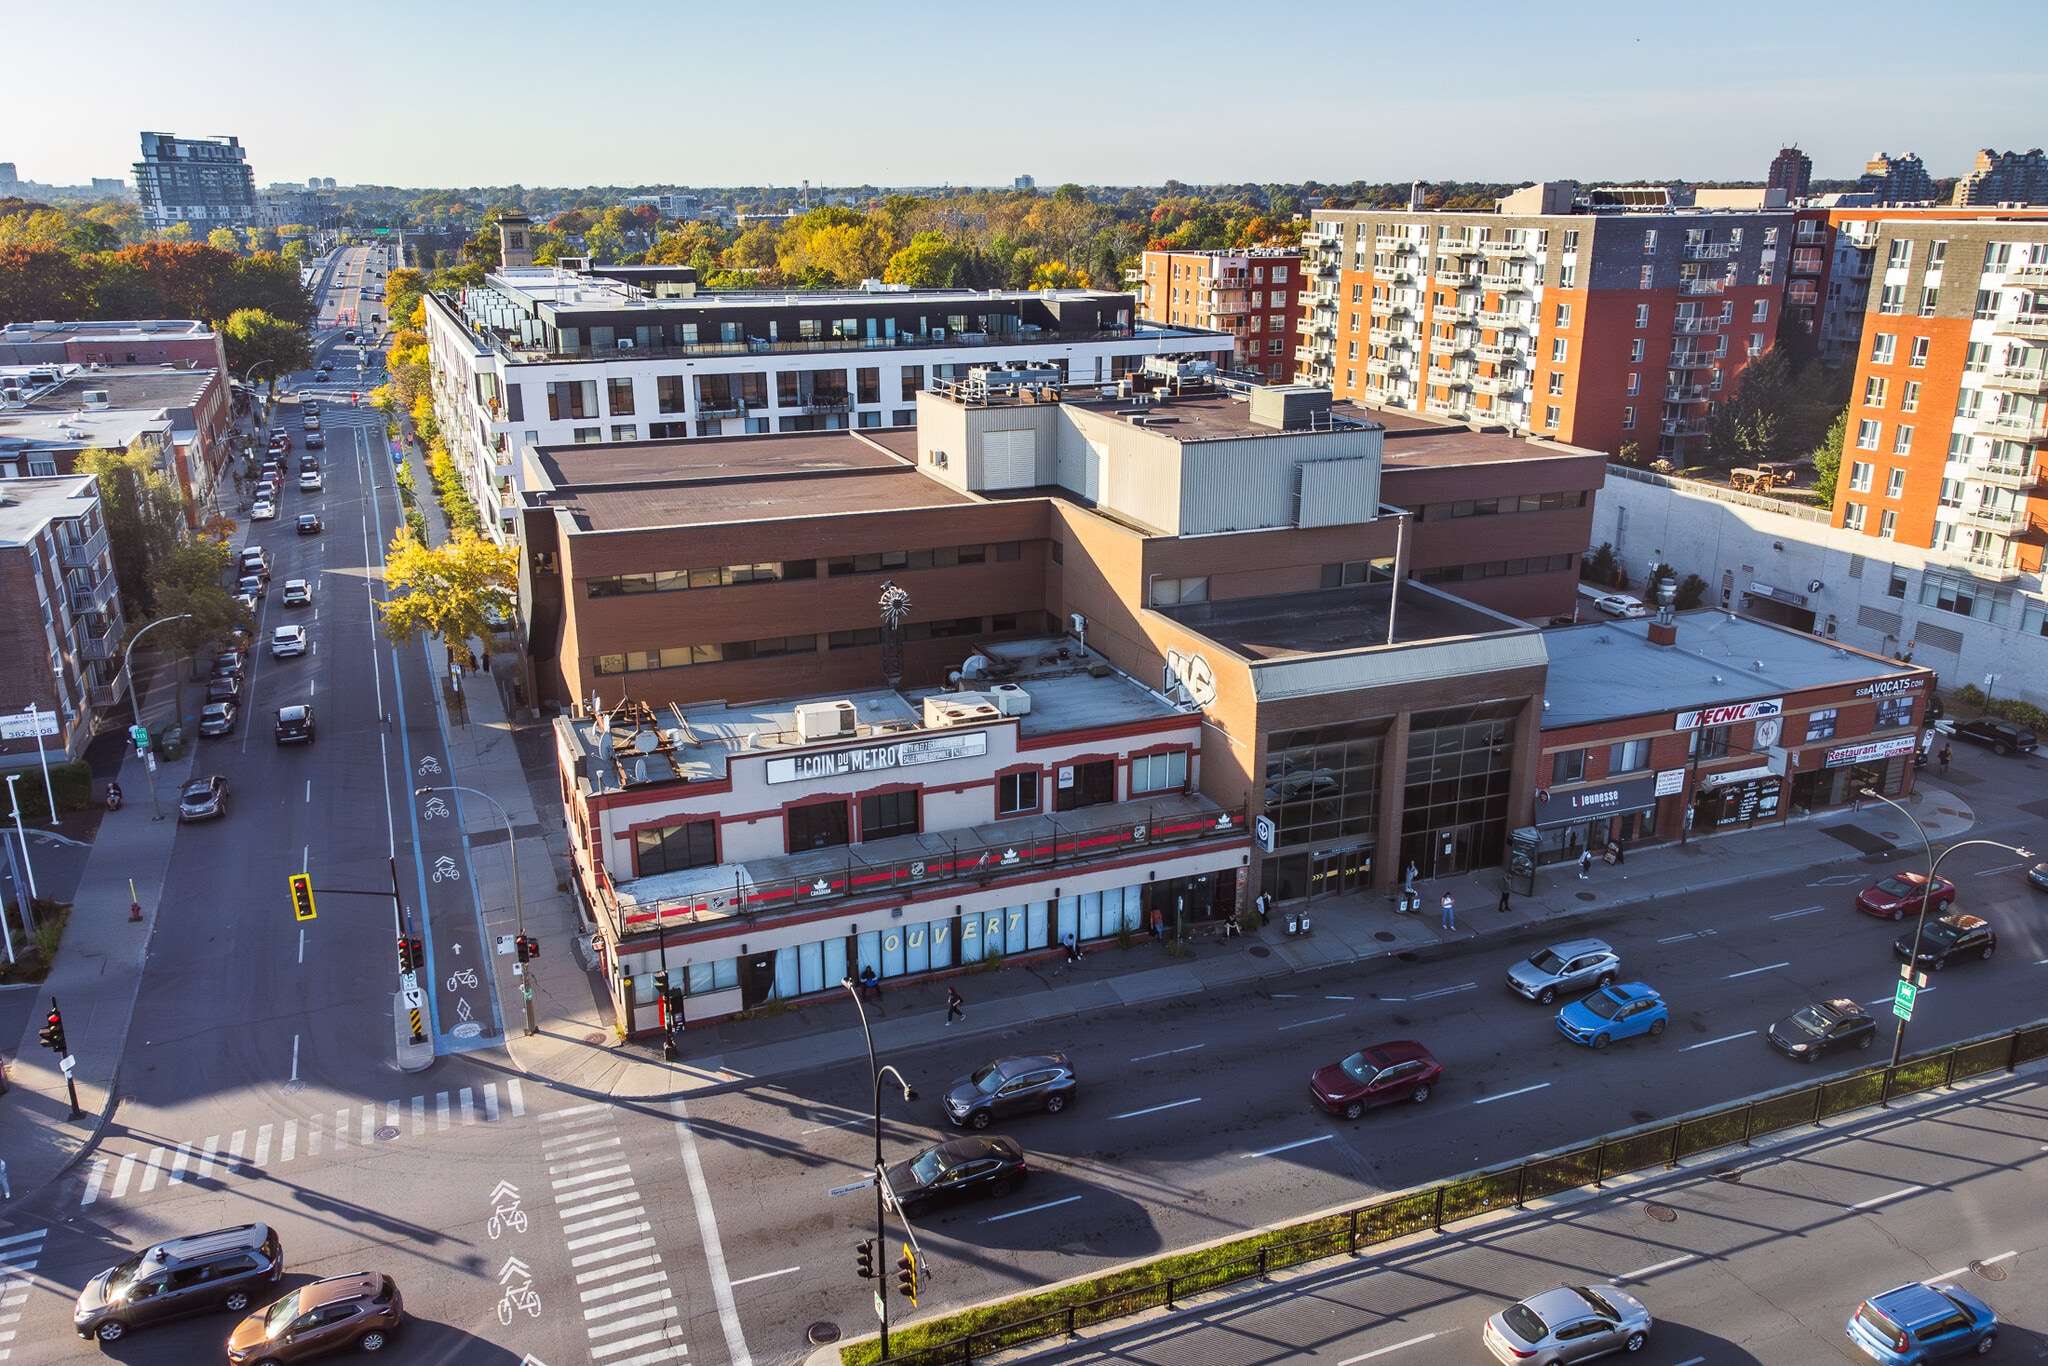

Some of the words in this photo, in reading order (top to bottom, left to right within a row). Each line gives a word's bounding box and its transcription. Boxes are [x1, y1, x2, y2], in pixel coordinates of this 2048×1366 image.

[1812, 581, 1820, 592] P
[1694, 703, 1751, 726] TECNIC
[804, 754, 835, 777] COIN
[838, 752, 849, 766] DU
[852, 746, 896, 771] METRO
[1828, 744, 1878, 760] Restaurant
[884, 913, 1022, 952] OUVERT
